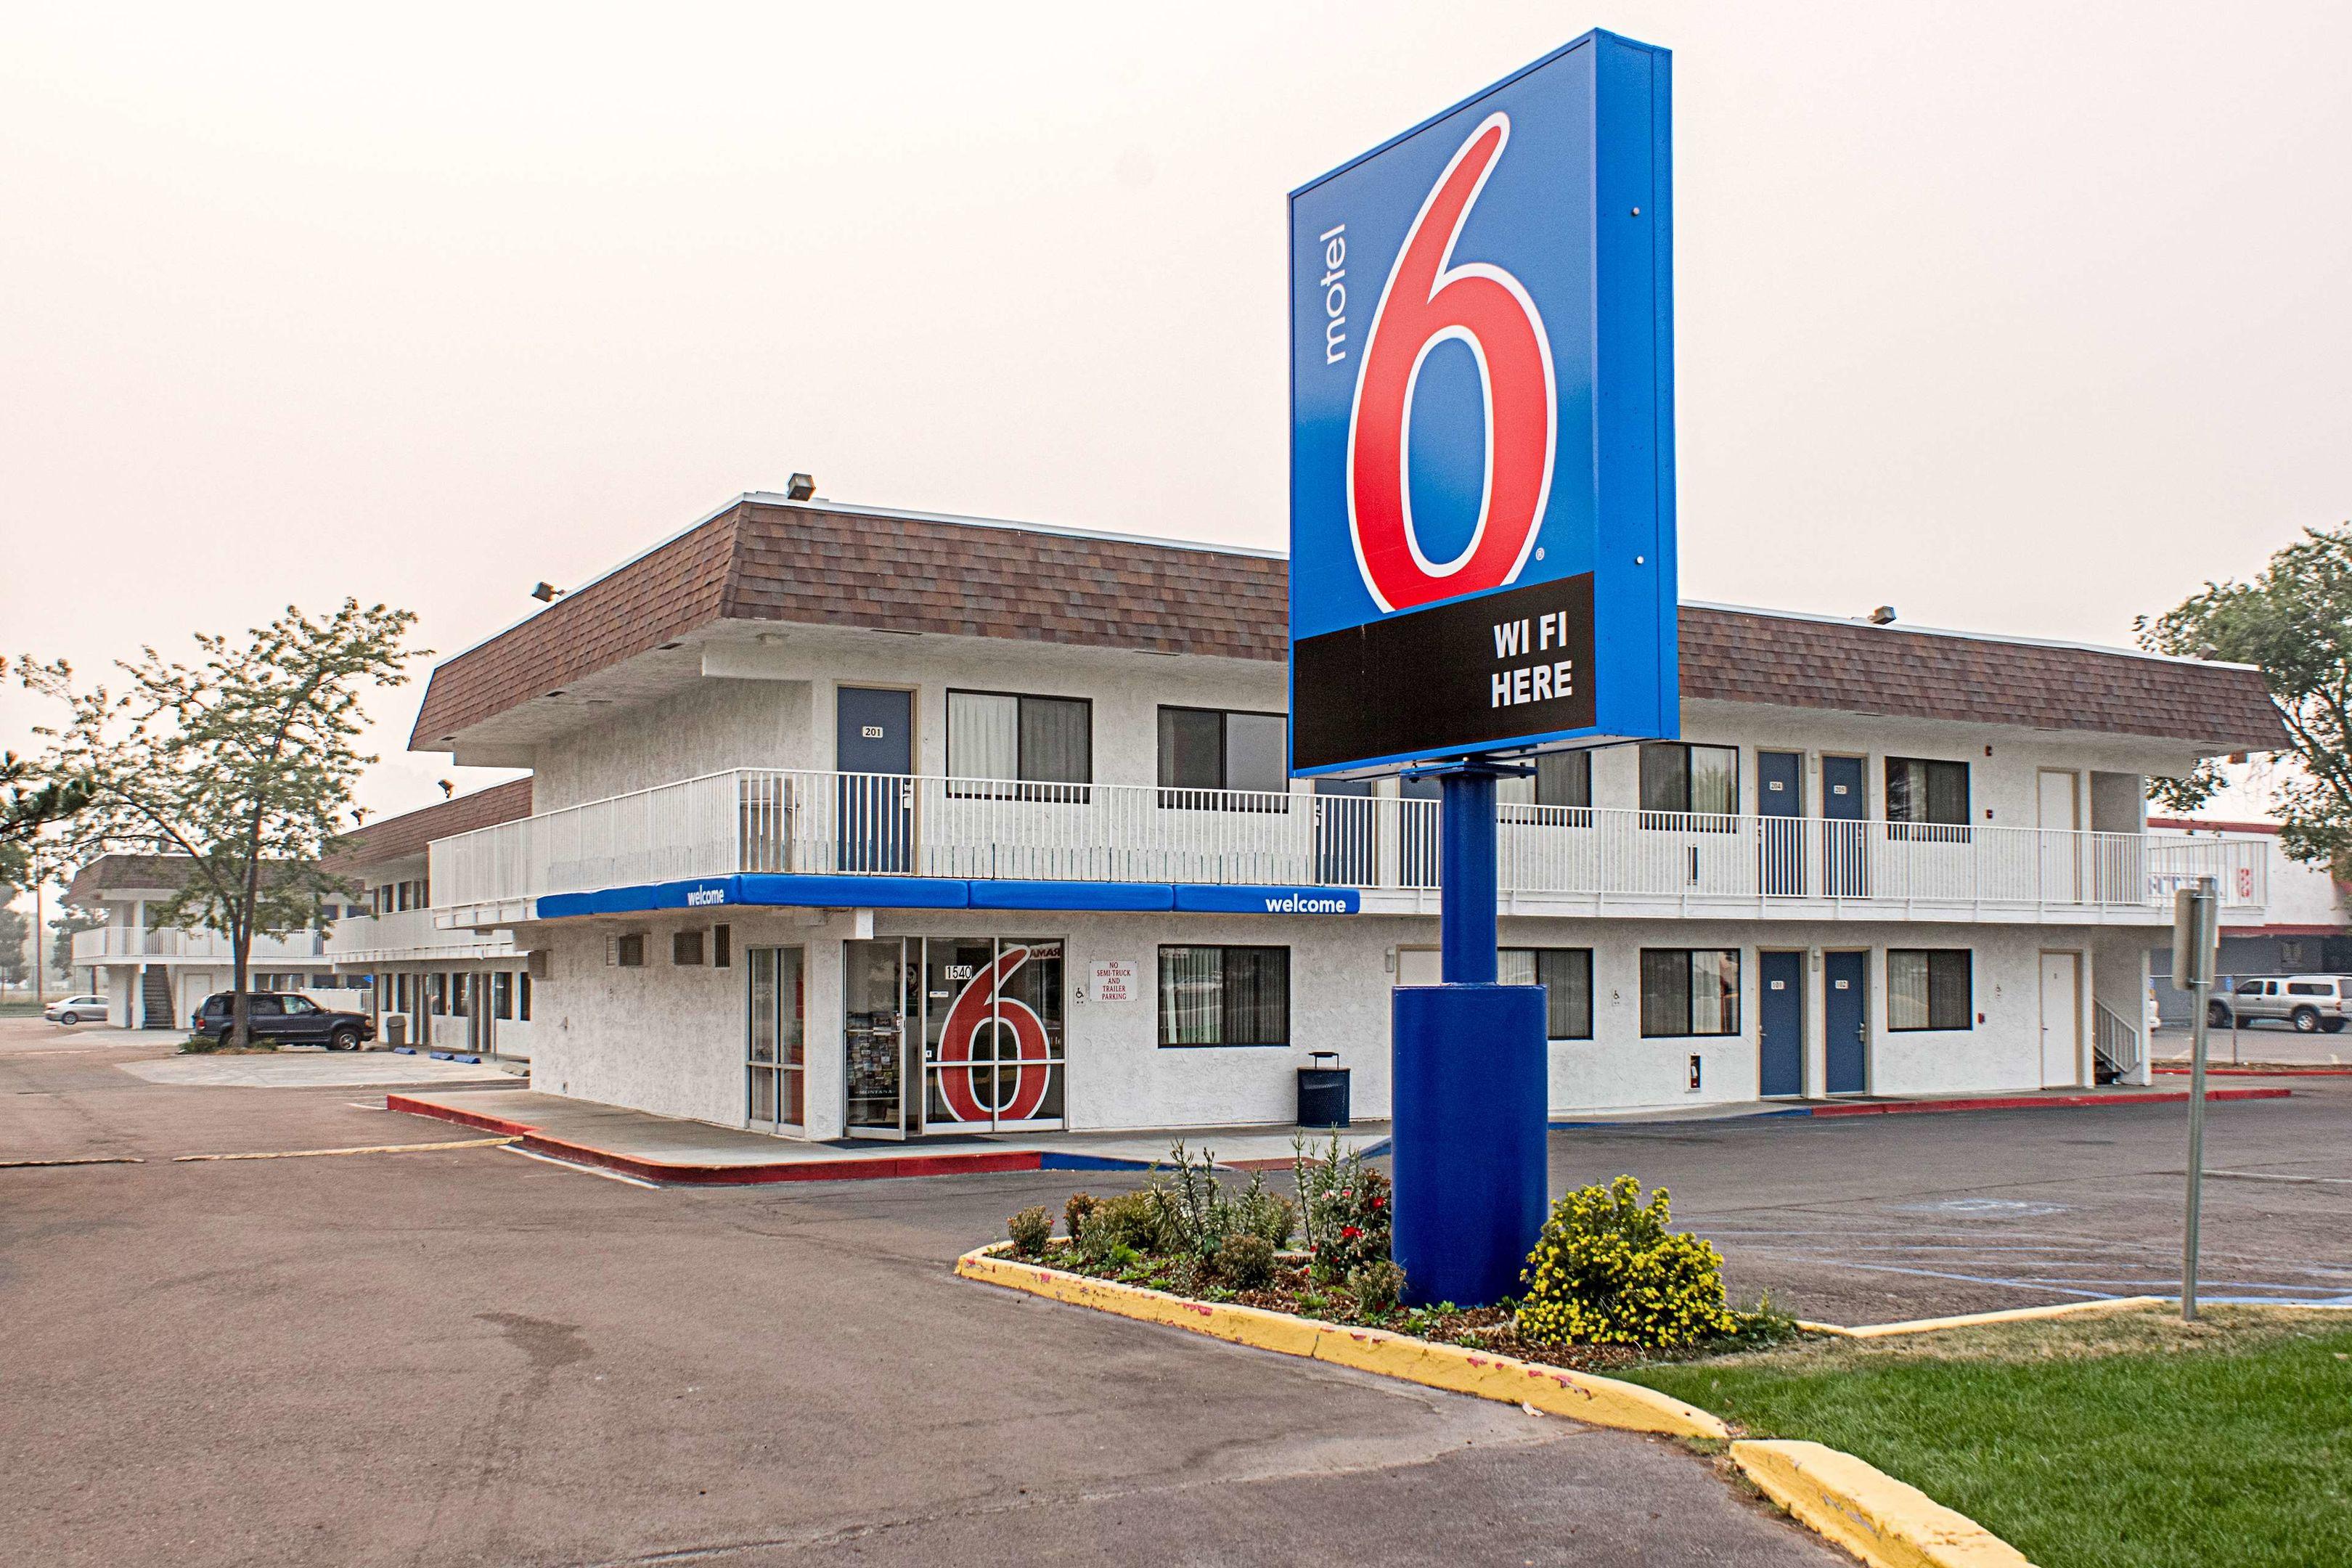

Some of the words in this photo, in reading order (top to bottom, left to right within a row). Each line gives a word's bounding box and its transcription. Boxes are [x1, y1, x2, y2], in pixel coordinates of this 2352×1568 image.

[1319, 224, 1346, 365] motel
[1347, 110, 1558, 613] 6
[1493, 618, 1530, 659] WI
[1540, 611, 1567, 650] FI
[1491, 660, 1572, 709] HERE
[687, 884, 724, 906] welcome
[1265, 893, 1347, 913] welcome
[947, 966, 972, 979] 1540
[937, 944, 1050, 1122] 6
